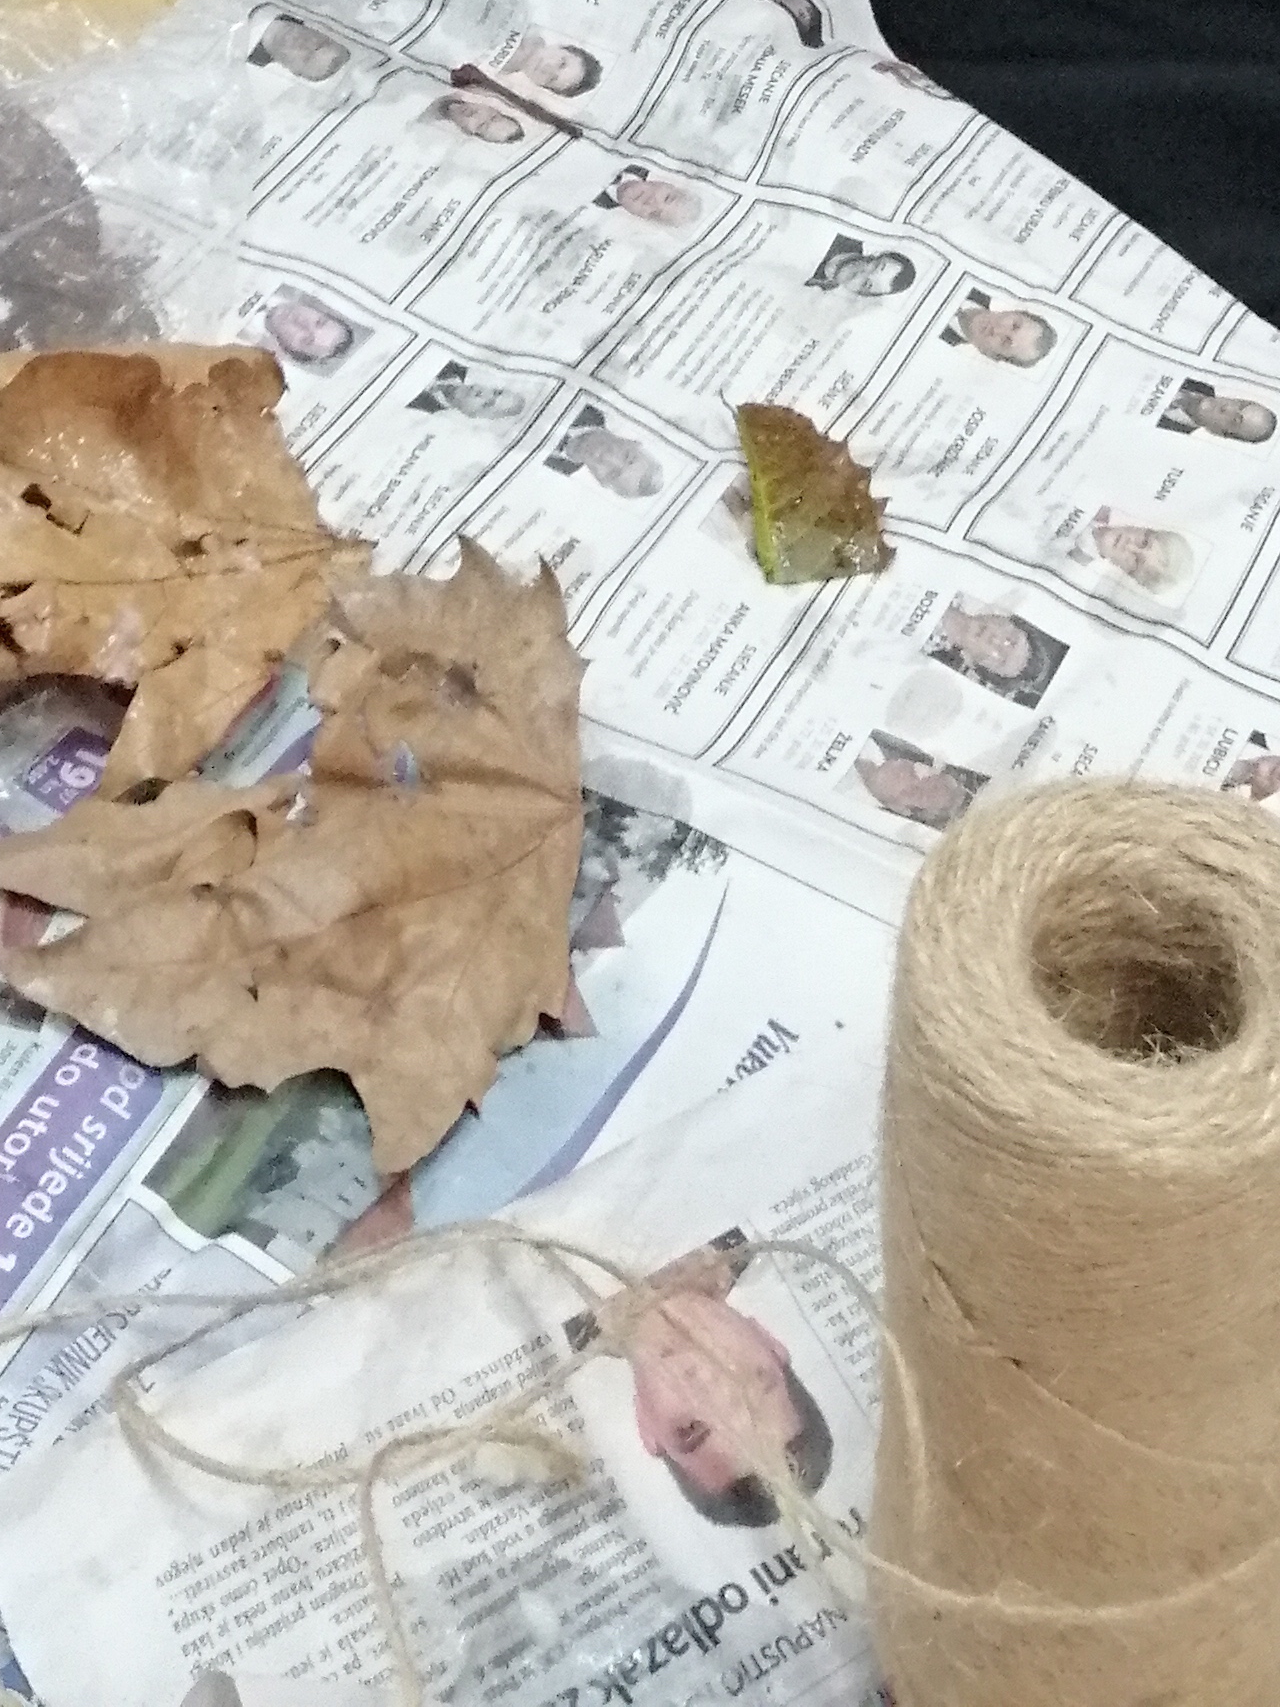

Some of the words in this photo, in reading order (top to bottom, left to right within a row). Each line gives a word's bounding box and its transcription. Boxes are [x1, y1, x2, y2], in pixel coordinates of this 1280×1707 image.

[729, 71, 761, 117] MESEK
[720, 599, 750, 636] ANKA
[663, 631, 727, 717] MATOVINOVIĆ
[1199, 724, 1238, 779] LJUBICU
[51, 1037, 105, 1096] do
[97, 1060, 150, 1118] od
[429, 1387, 457, 1410] Od
[206, 1523, 255, 1560] jedan
[248, 1519, 316, 1563] tambure
[150, 1549, 205, 1589] njegov
[179, 1631, 214, 1658] laka
[585, 1574, 756, 1707] odlazak
